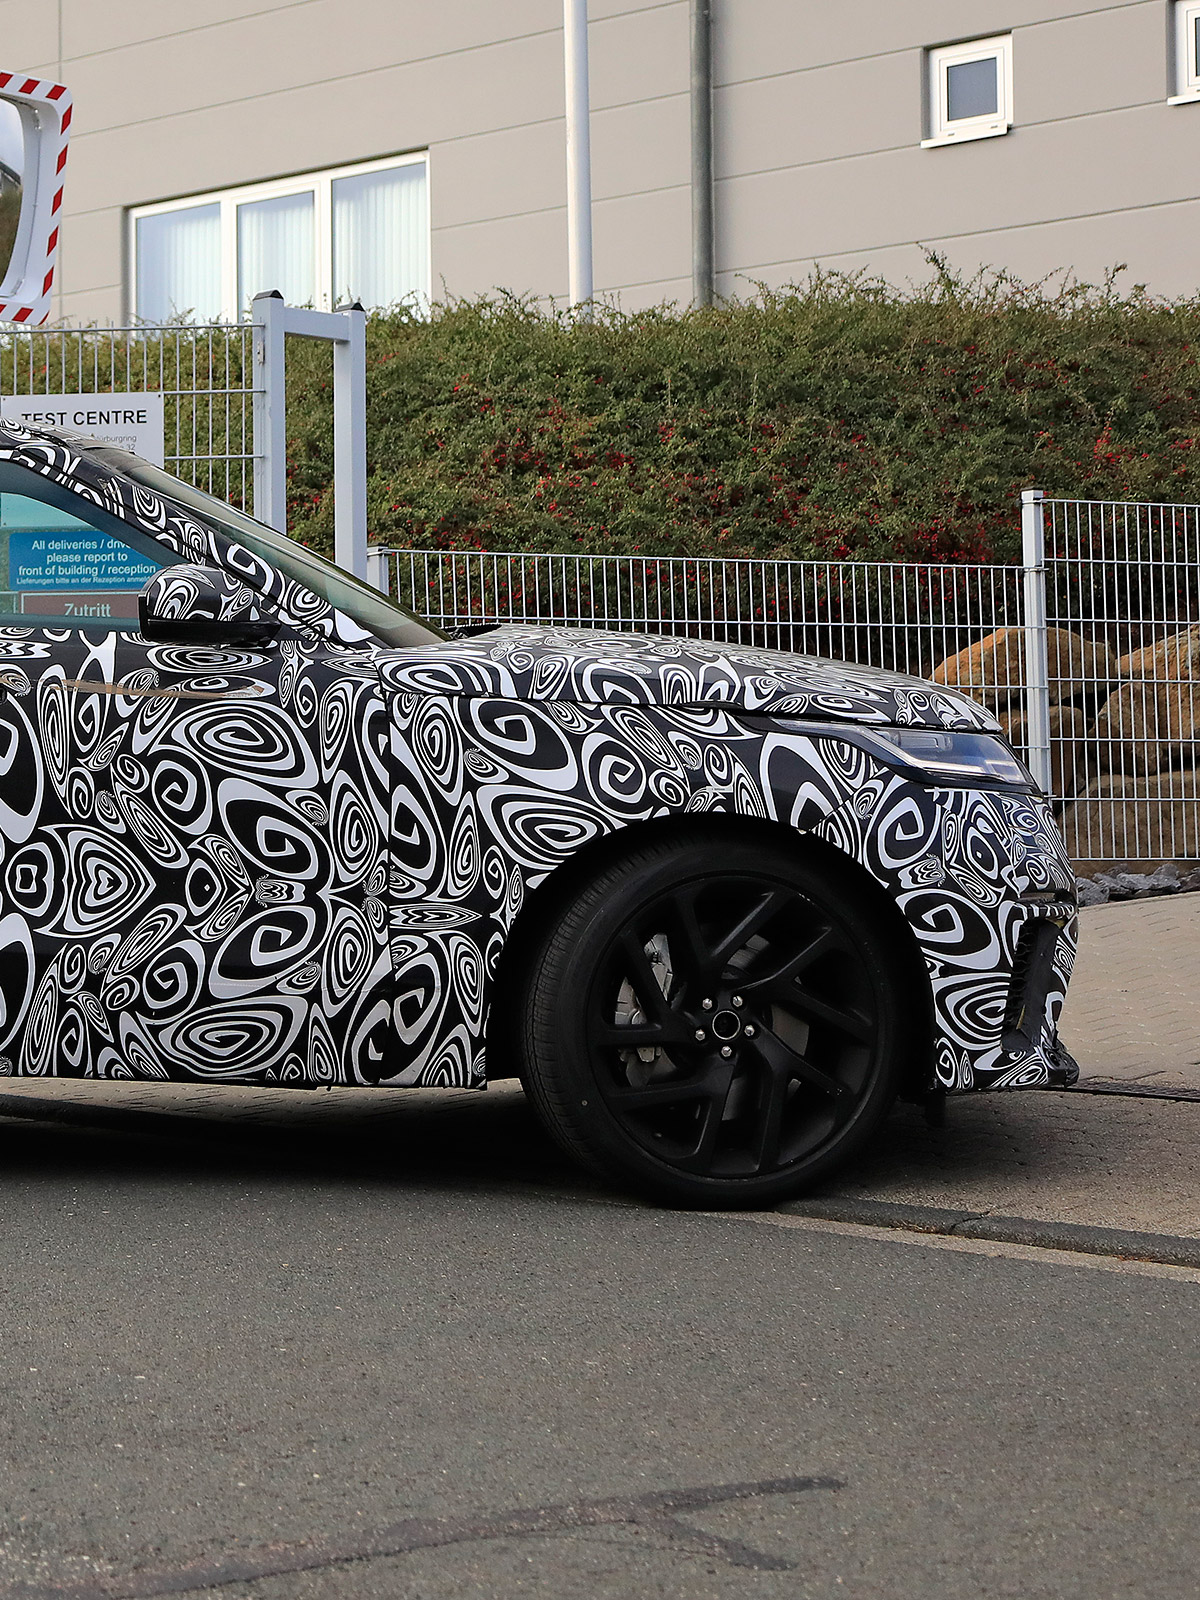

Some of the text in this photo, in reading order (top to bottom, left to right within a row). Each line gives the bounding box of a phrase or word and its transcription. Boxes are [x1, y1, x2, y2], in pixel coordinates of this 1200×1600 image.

[21, 410, 147, 426] TEST CENTRE
[32, 540, 45, 550] All
[48, 539, 98, 550] deliveries
[46, 552, 128, 565] please report to
[18, 565, 43, 576] front
[45, 565, 55, 576] of
[58, 565, 99, 577] building
[107, 563, 156, 577] reception
[16, 577, 55, 585] Lieferungen
[64, 603, 112, 617] Zutritt
